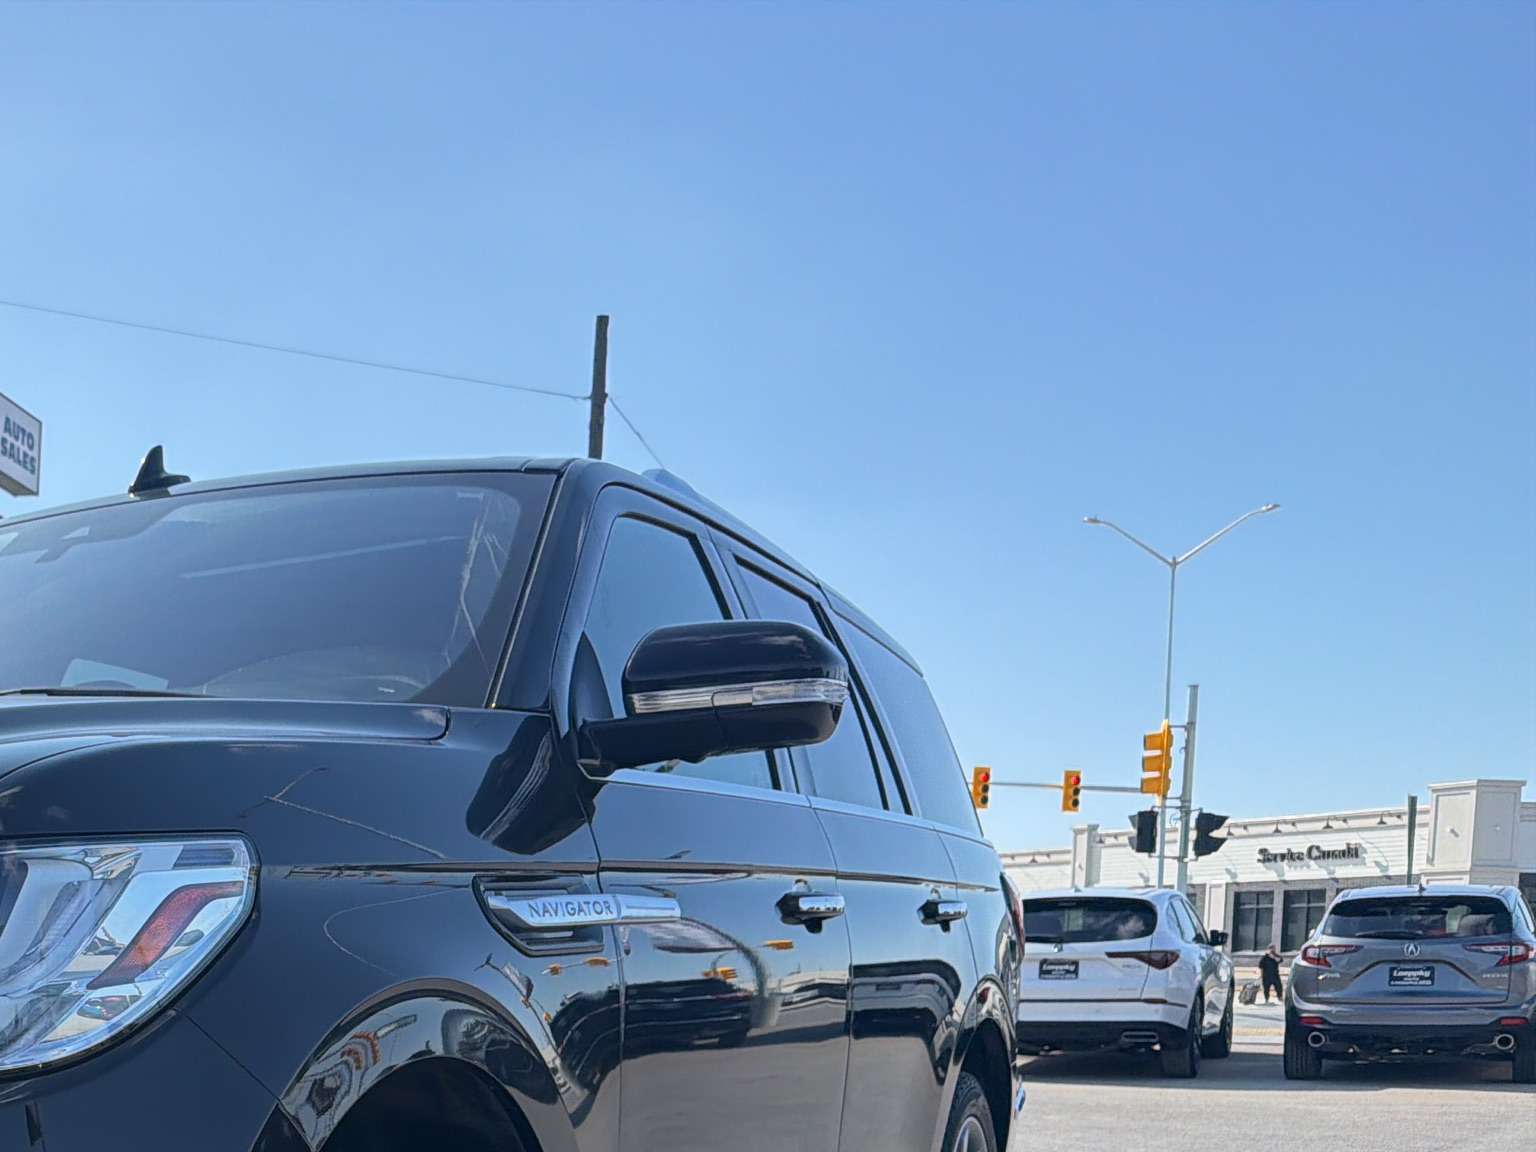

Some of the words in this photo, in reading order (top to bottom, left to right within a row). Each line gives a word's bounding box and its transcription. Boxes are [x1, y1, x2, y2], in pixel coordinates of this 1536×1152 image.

[3, 416, 35, 450] AUTO
[0, 437, 37, 476] SALES
[1257, 847, 1305, 863] Service
[1306, 843, 1360, 860] Canada
[528, 900, 614, 918] NAVIGATOR
